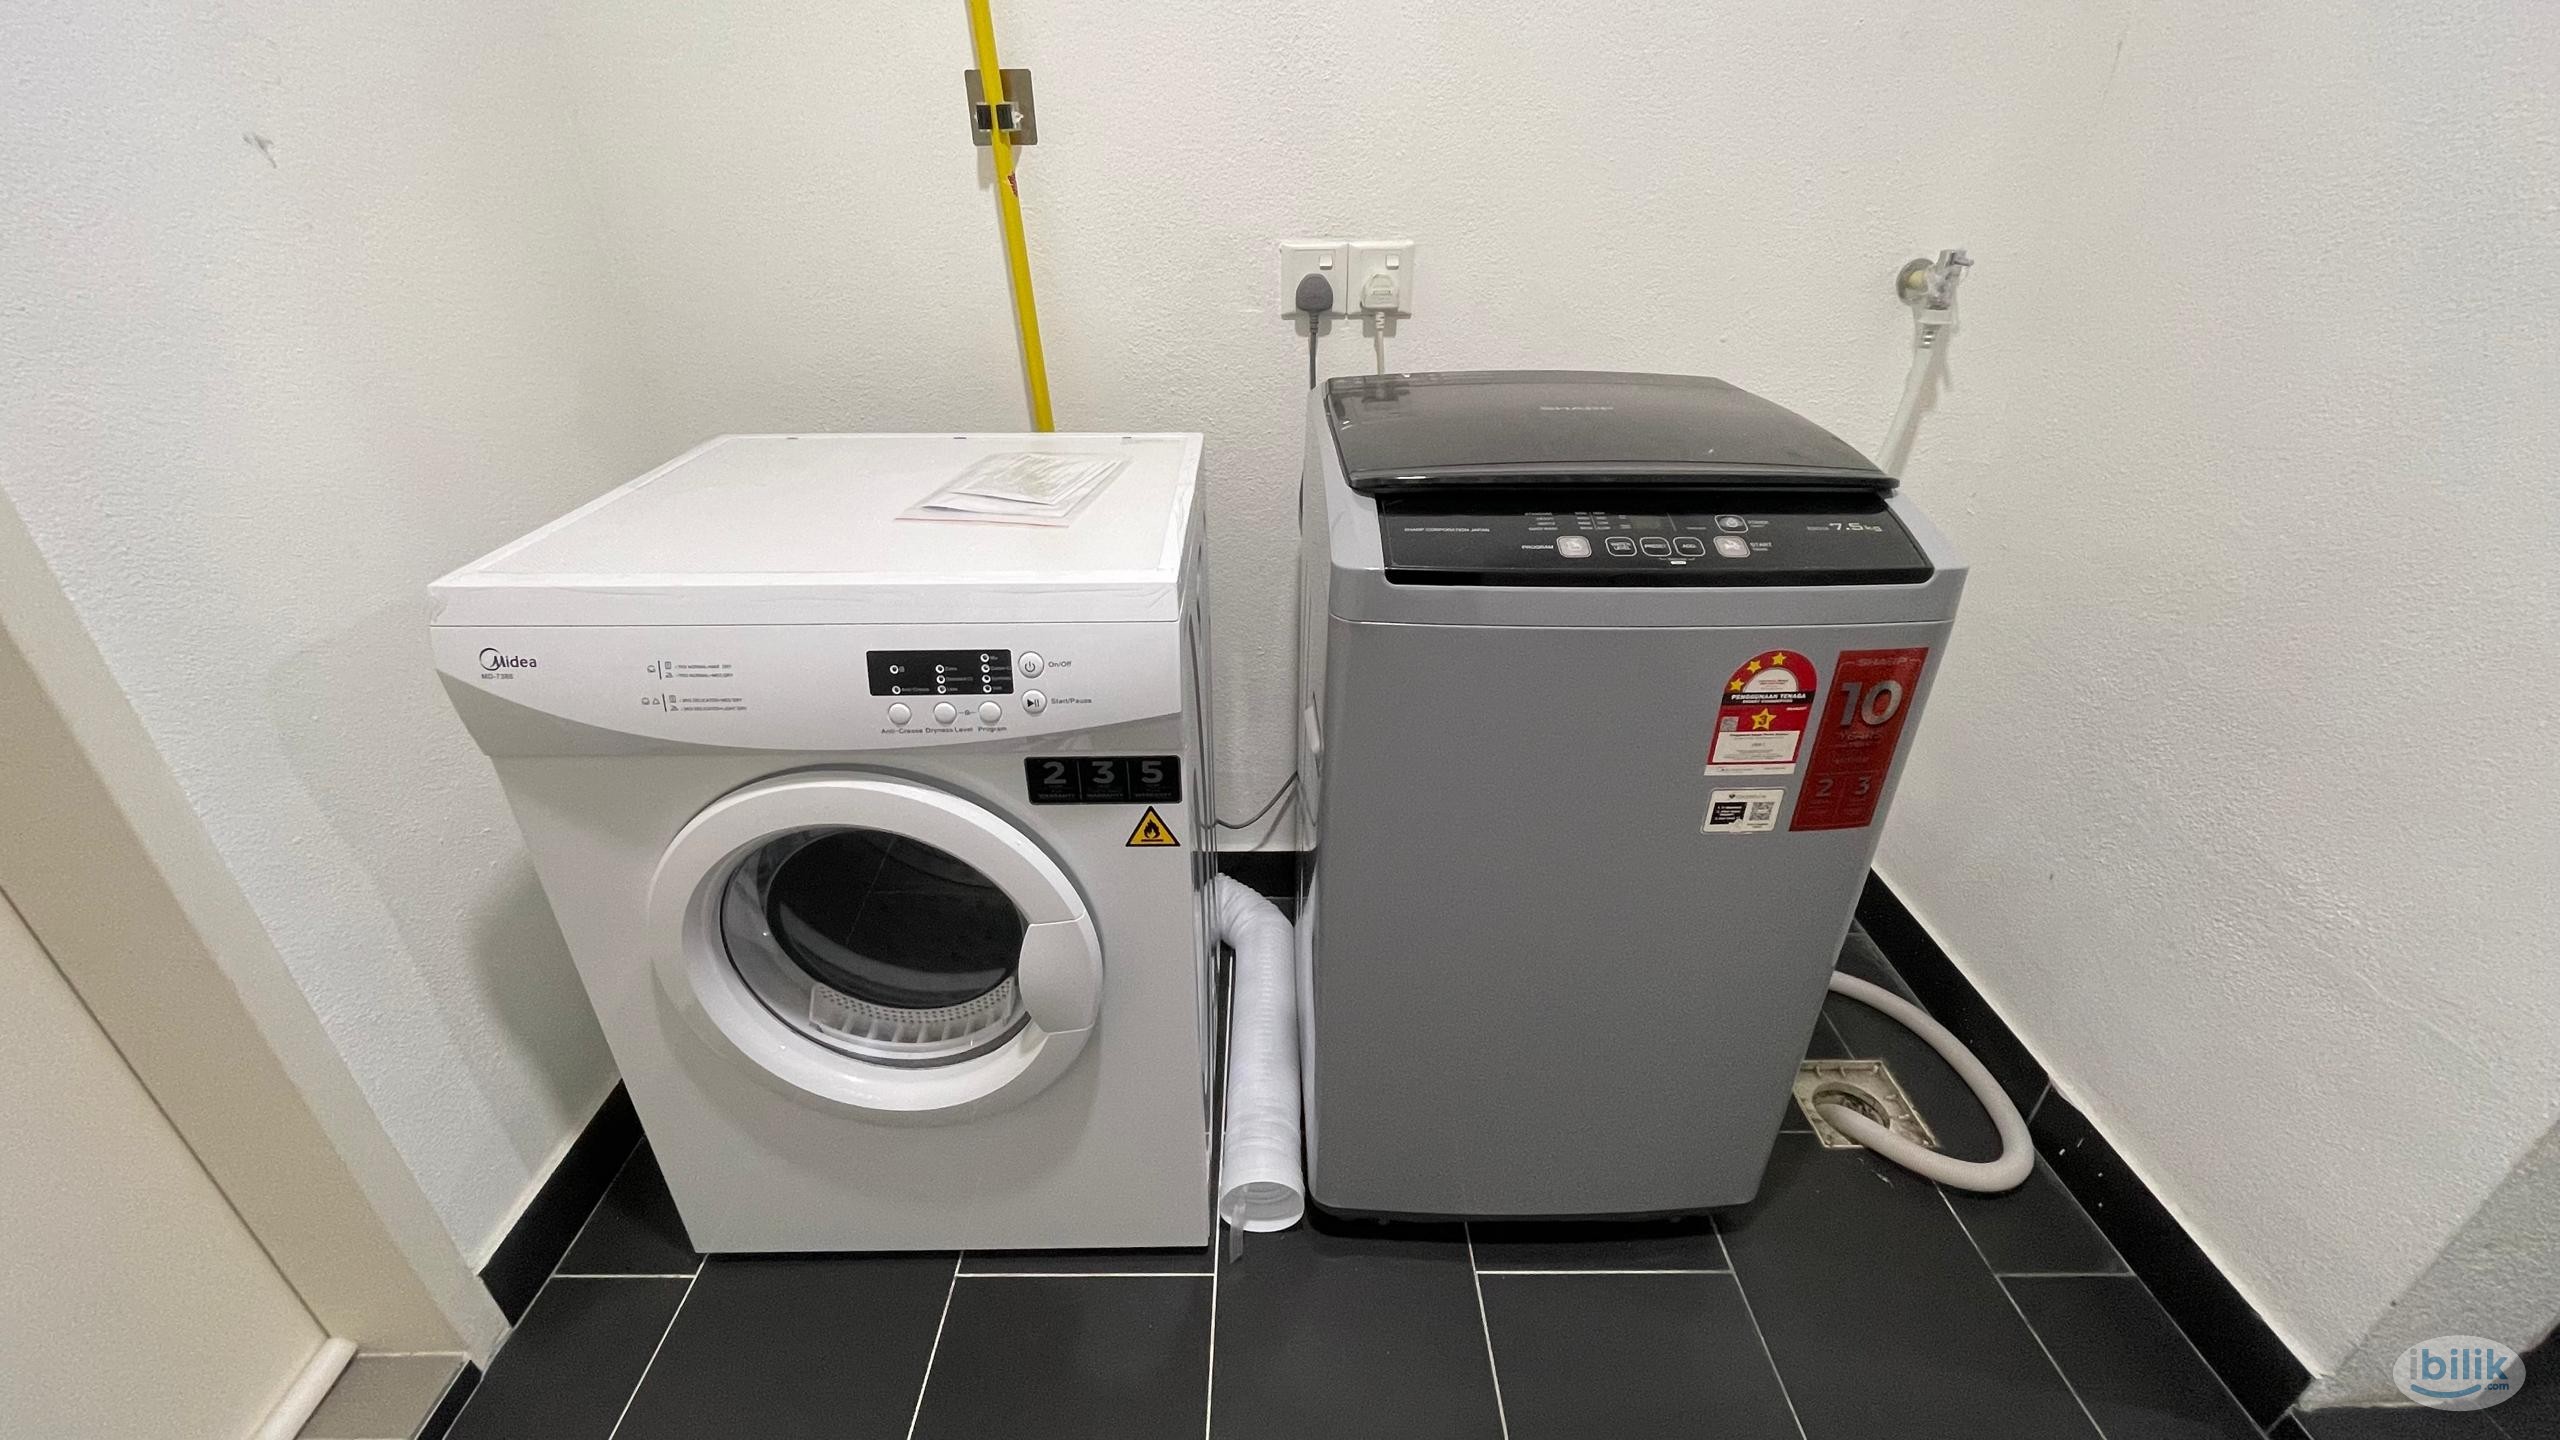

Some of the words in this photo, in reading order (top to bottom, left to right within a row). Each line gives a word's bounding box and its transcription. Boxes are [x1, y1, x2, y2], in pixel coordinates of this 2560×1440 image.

[479, 647, 537, 671] Midea
[1048, 660, 1072, 668] On/Off
[1050, 697, 1092, 705] Start/Pause
[1840, 679, 1903, 727] 10
[1758, 714, 1768, 725] 3
[978, 725, 1007, 733] Program
[1042, 761, 1067, 785] 2
[1091, 760, 1115, 784] 3
[1141, 760, 1164, 784] 5
[1816, 779, 1833, 797] 2
[1855, 775, 1872, 796] 3
